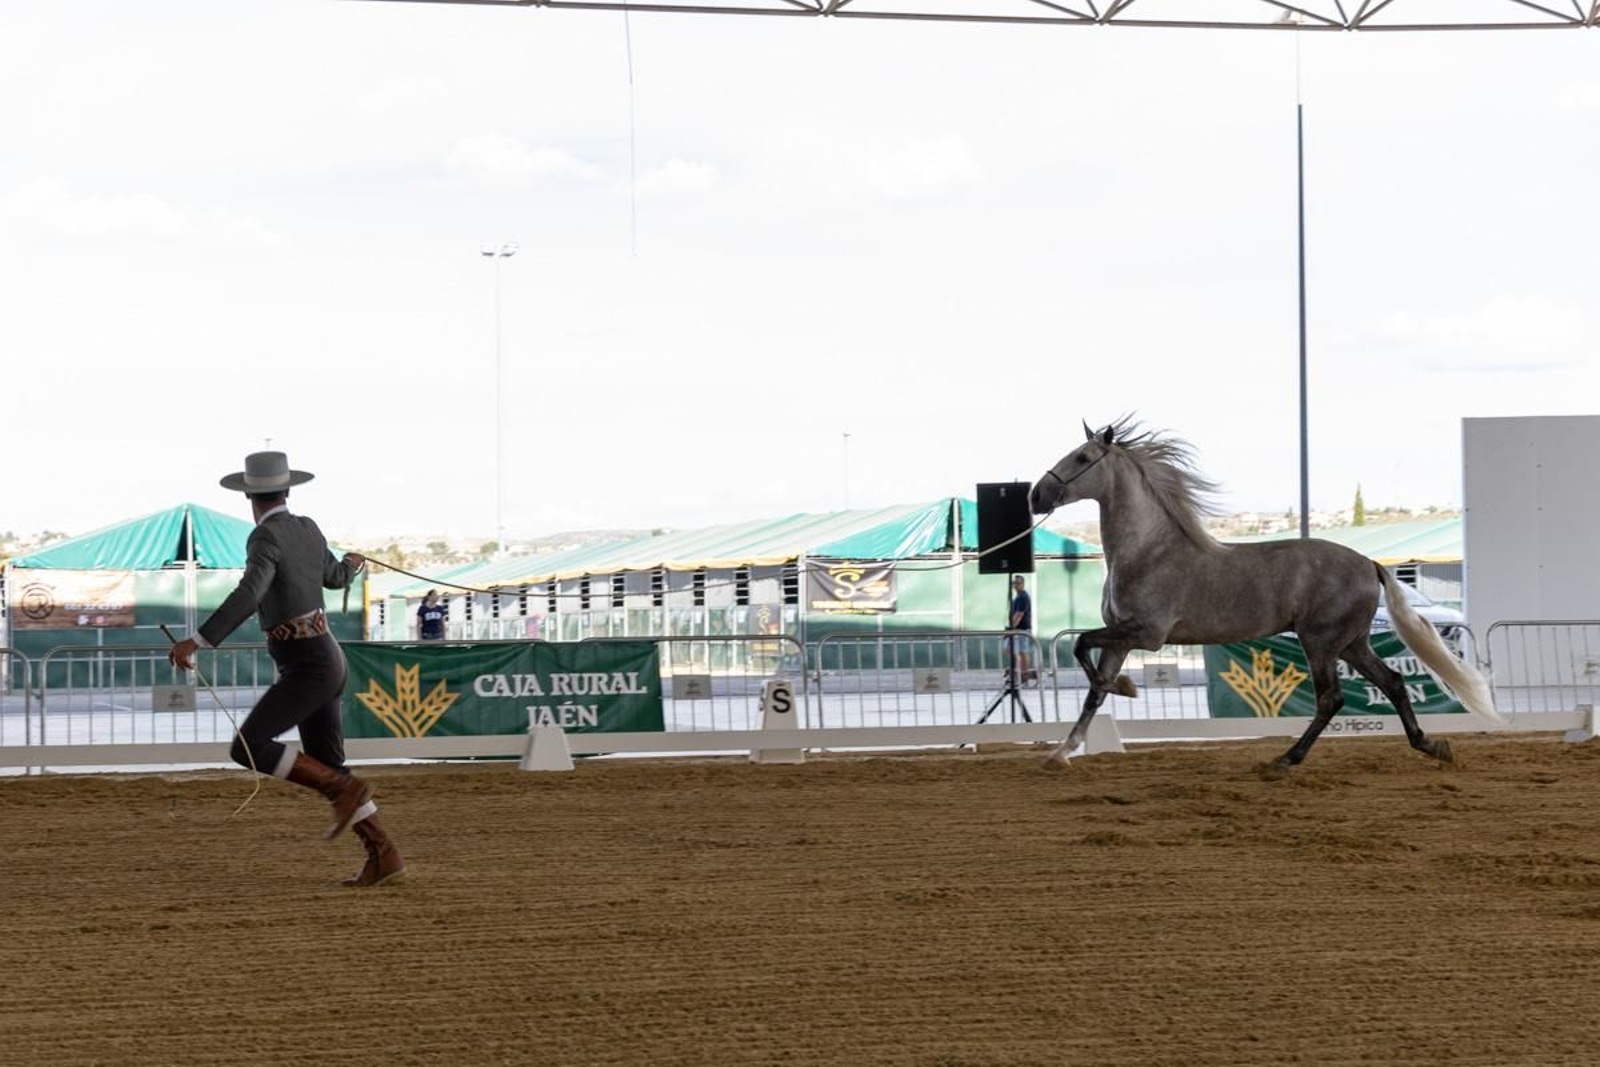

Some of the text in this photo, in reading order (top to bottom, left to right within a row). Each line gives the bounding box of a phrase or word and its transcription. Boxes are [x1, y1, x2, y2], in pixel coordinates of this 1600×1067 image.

[473, 672, 648, 698] CAJA RURAL
[1362, 683, 1426, 707] JAN
[772, 688, 791, 714] S
[526, 701, 598, 730] JAÉN
